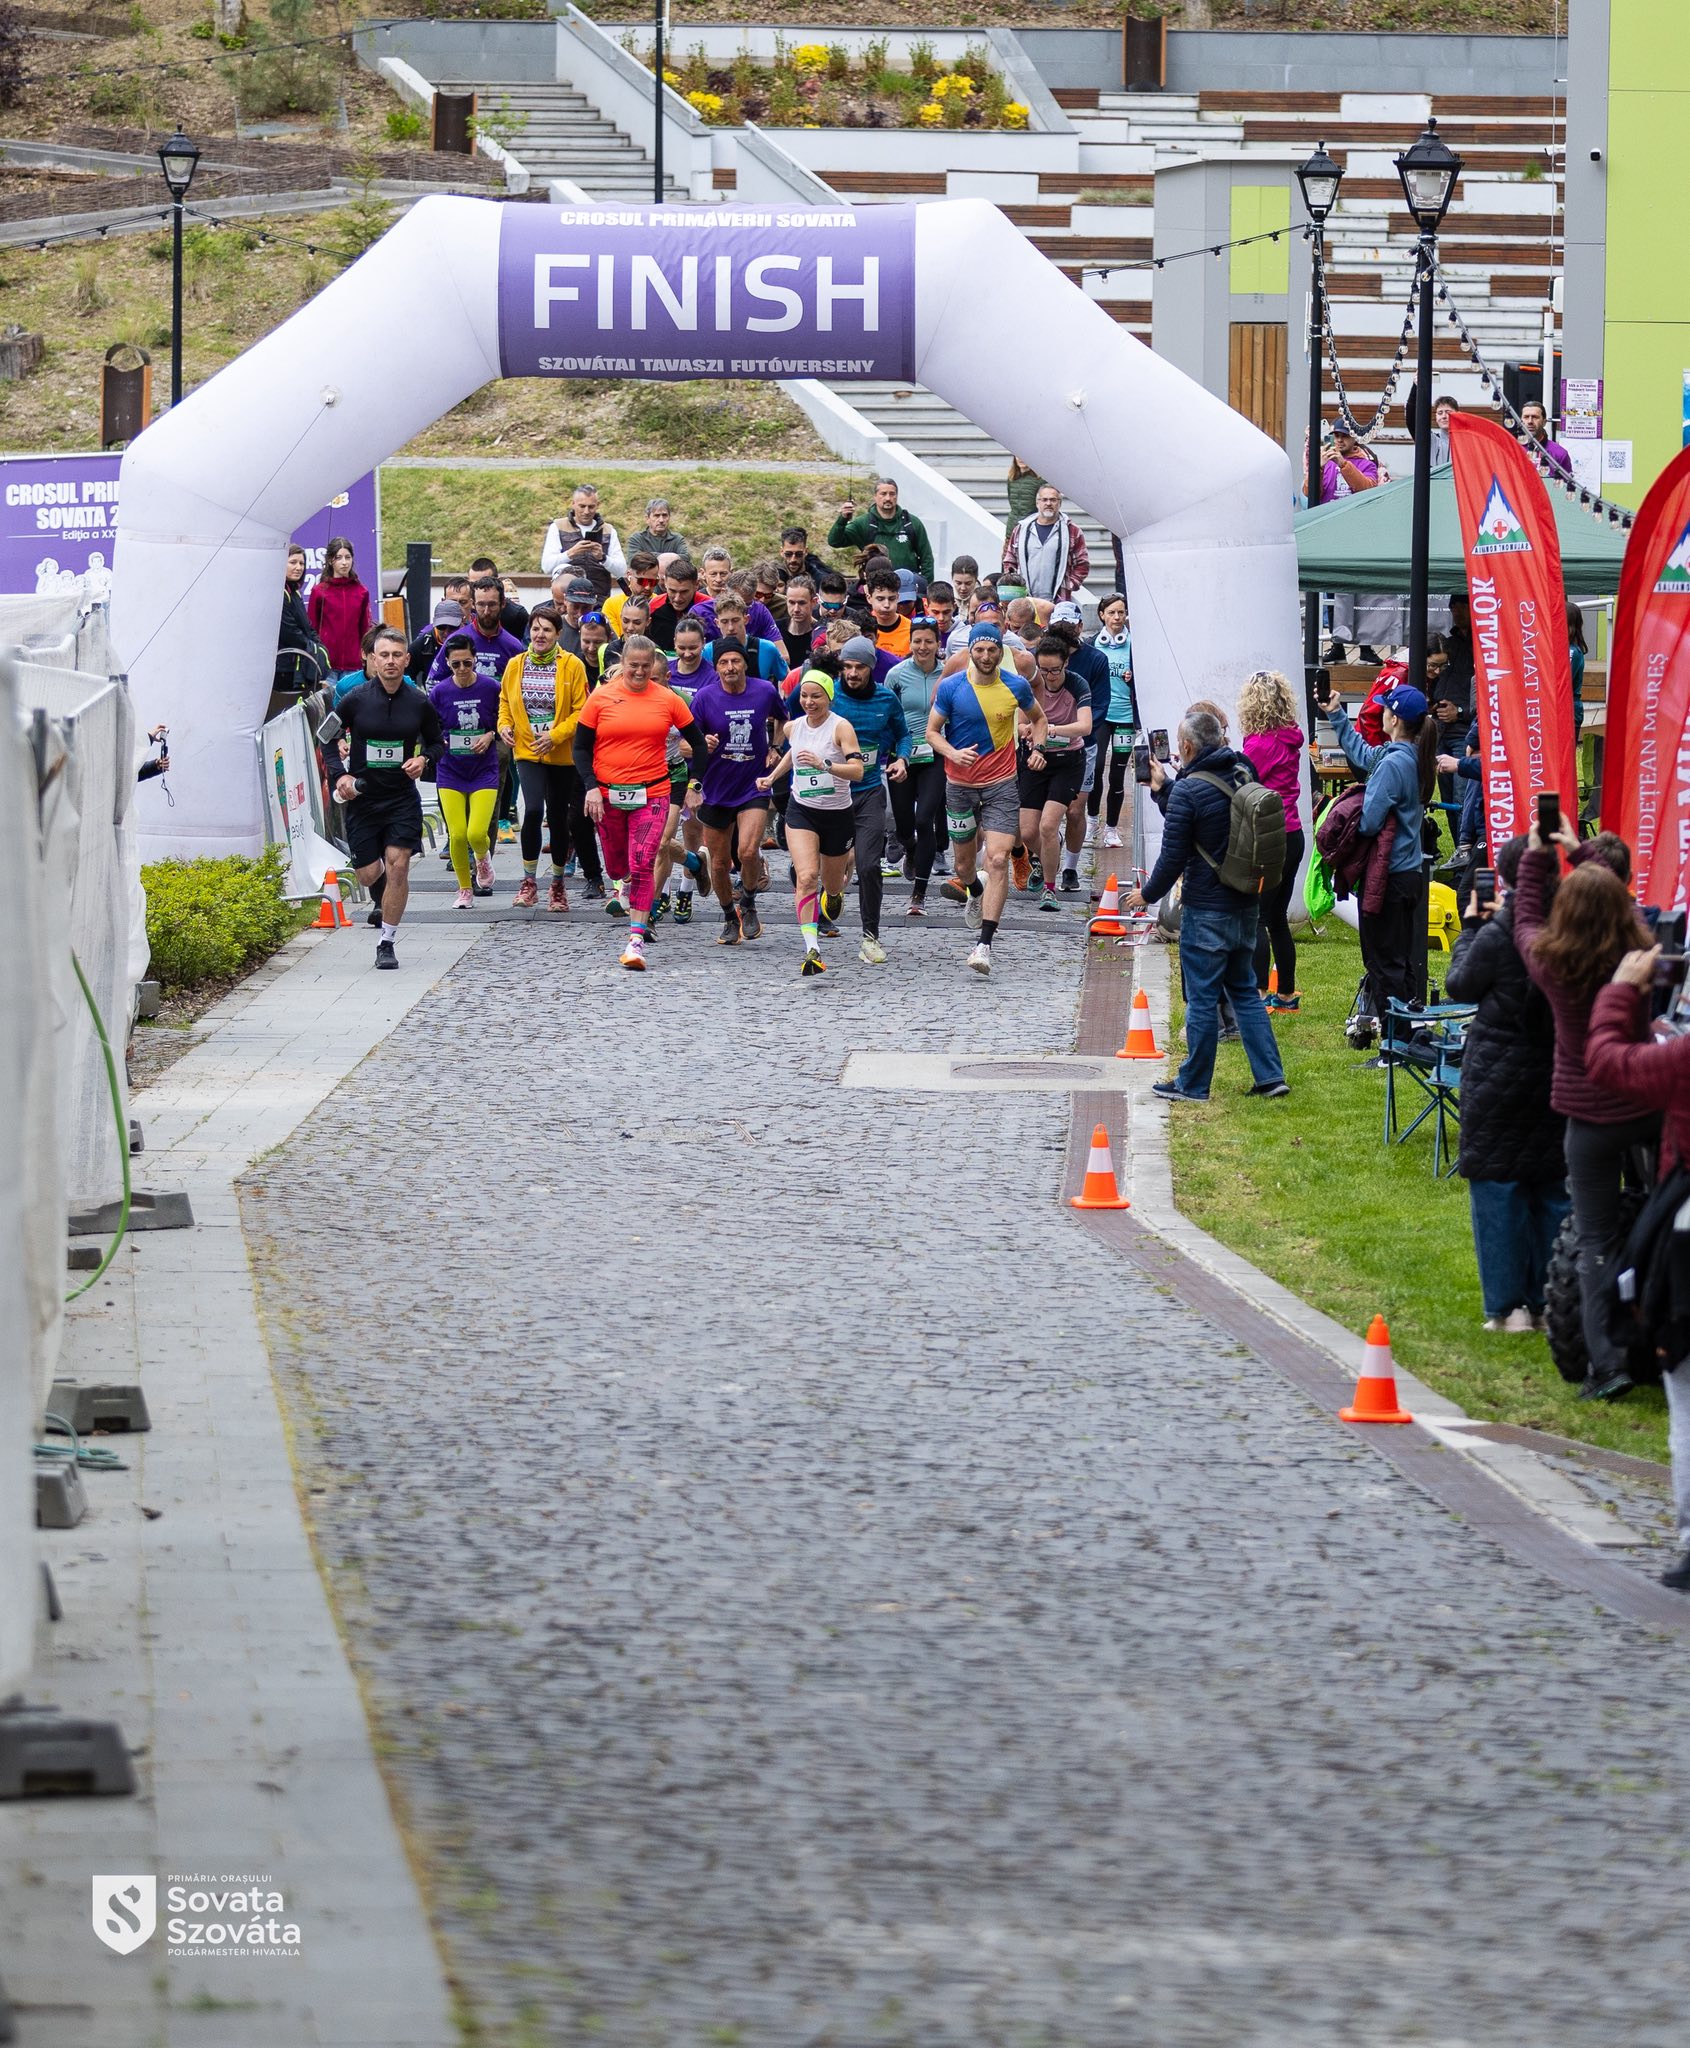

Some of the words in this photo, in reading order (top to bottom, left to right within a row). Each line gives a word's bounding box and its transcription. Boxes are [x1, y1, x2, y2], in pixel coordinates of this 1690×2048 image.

[560, 211, 645, 226] CROSUL
[776, 213, 857, 228] SOVATA
[534, 253, 880, 333] FINISH
[538, 355, 636, 371] SZOVÁTAI
[640, 358, 724, 373] TAVASZI
[730, 357, 875, 373] FUTÓVERSENY
[6, 482, 79, 506] CROSUL
[36, 506, 107, 530] SOVATA
[91, 531, 99, 539] a
[1642, 653, 1669, 732] MUREȘ
[533, 723, 550, 733] 14
[463, 736, 471, 746] 8
[1119, 735, 1132, 744] 13
[376, 748, 394, 759] 19
[809, 775, 818, 787] 6
[618, 791, 636, 801] 57
[1637, 739, 1662, 861] JUDEȚEAN
[951, 819, 967, 829] 34
